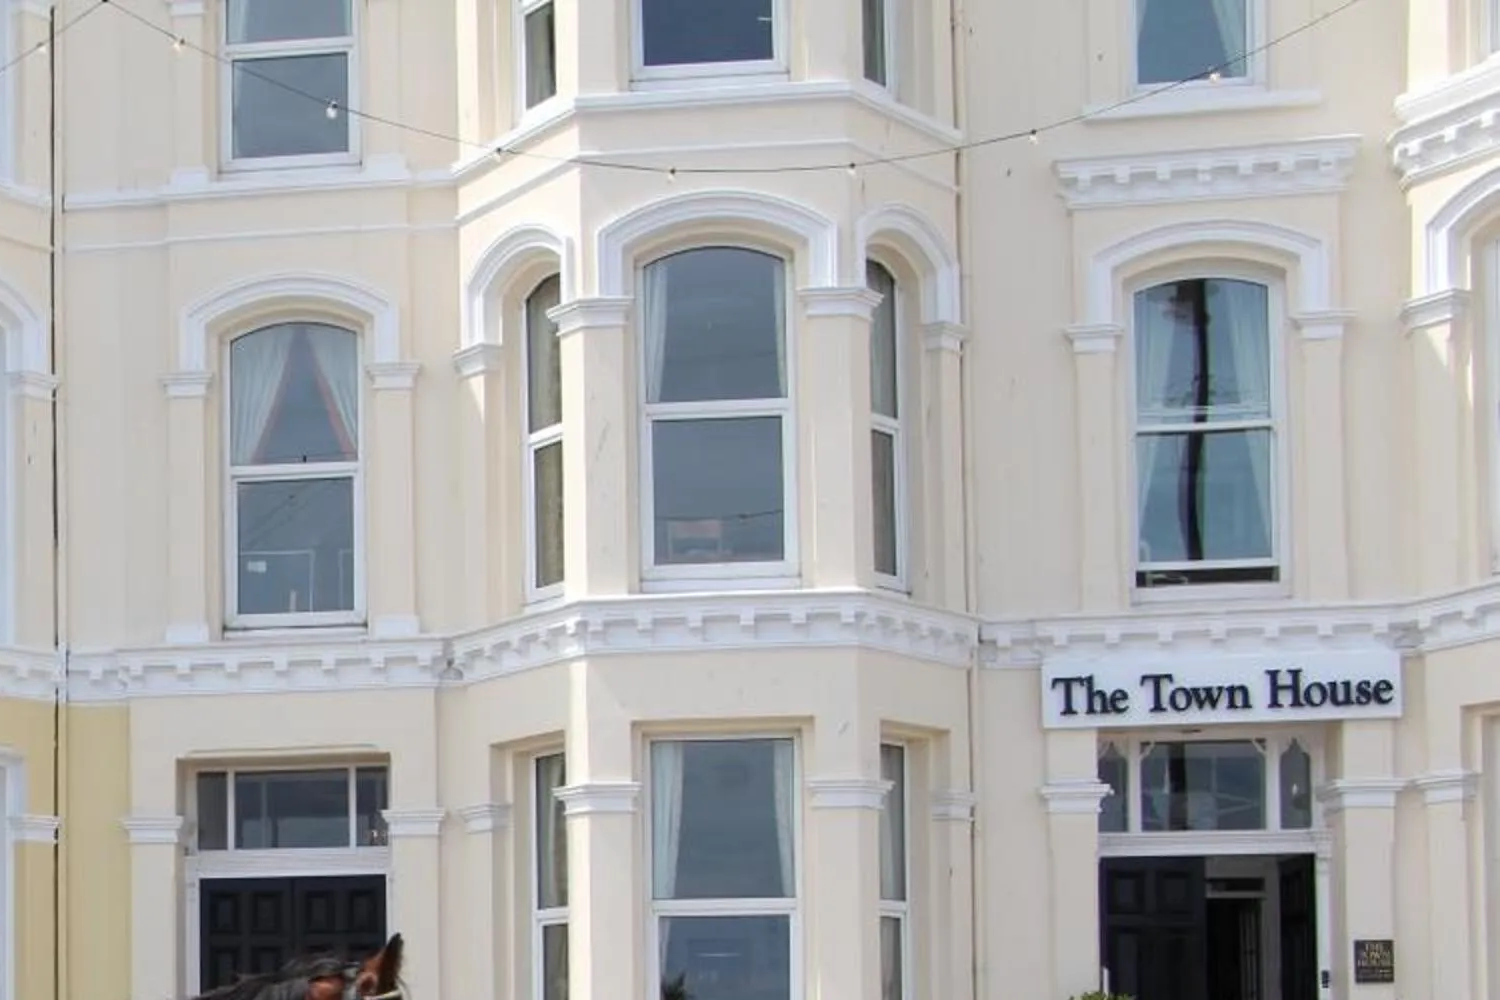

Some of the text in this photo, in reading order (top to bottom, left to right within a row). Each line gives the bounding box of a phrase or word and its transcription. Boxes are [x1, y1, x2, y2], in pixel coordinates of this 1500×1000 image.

[1051, 667, 1394, 716] The Town House
